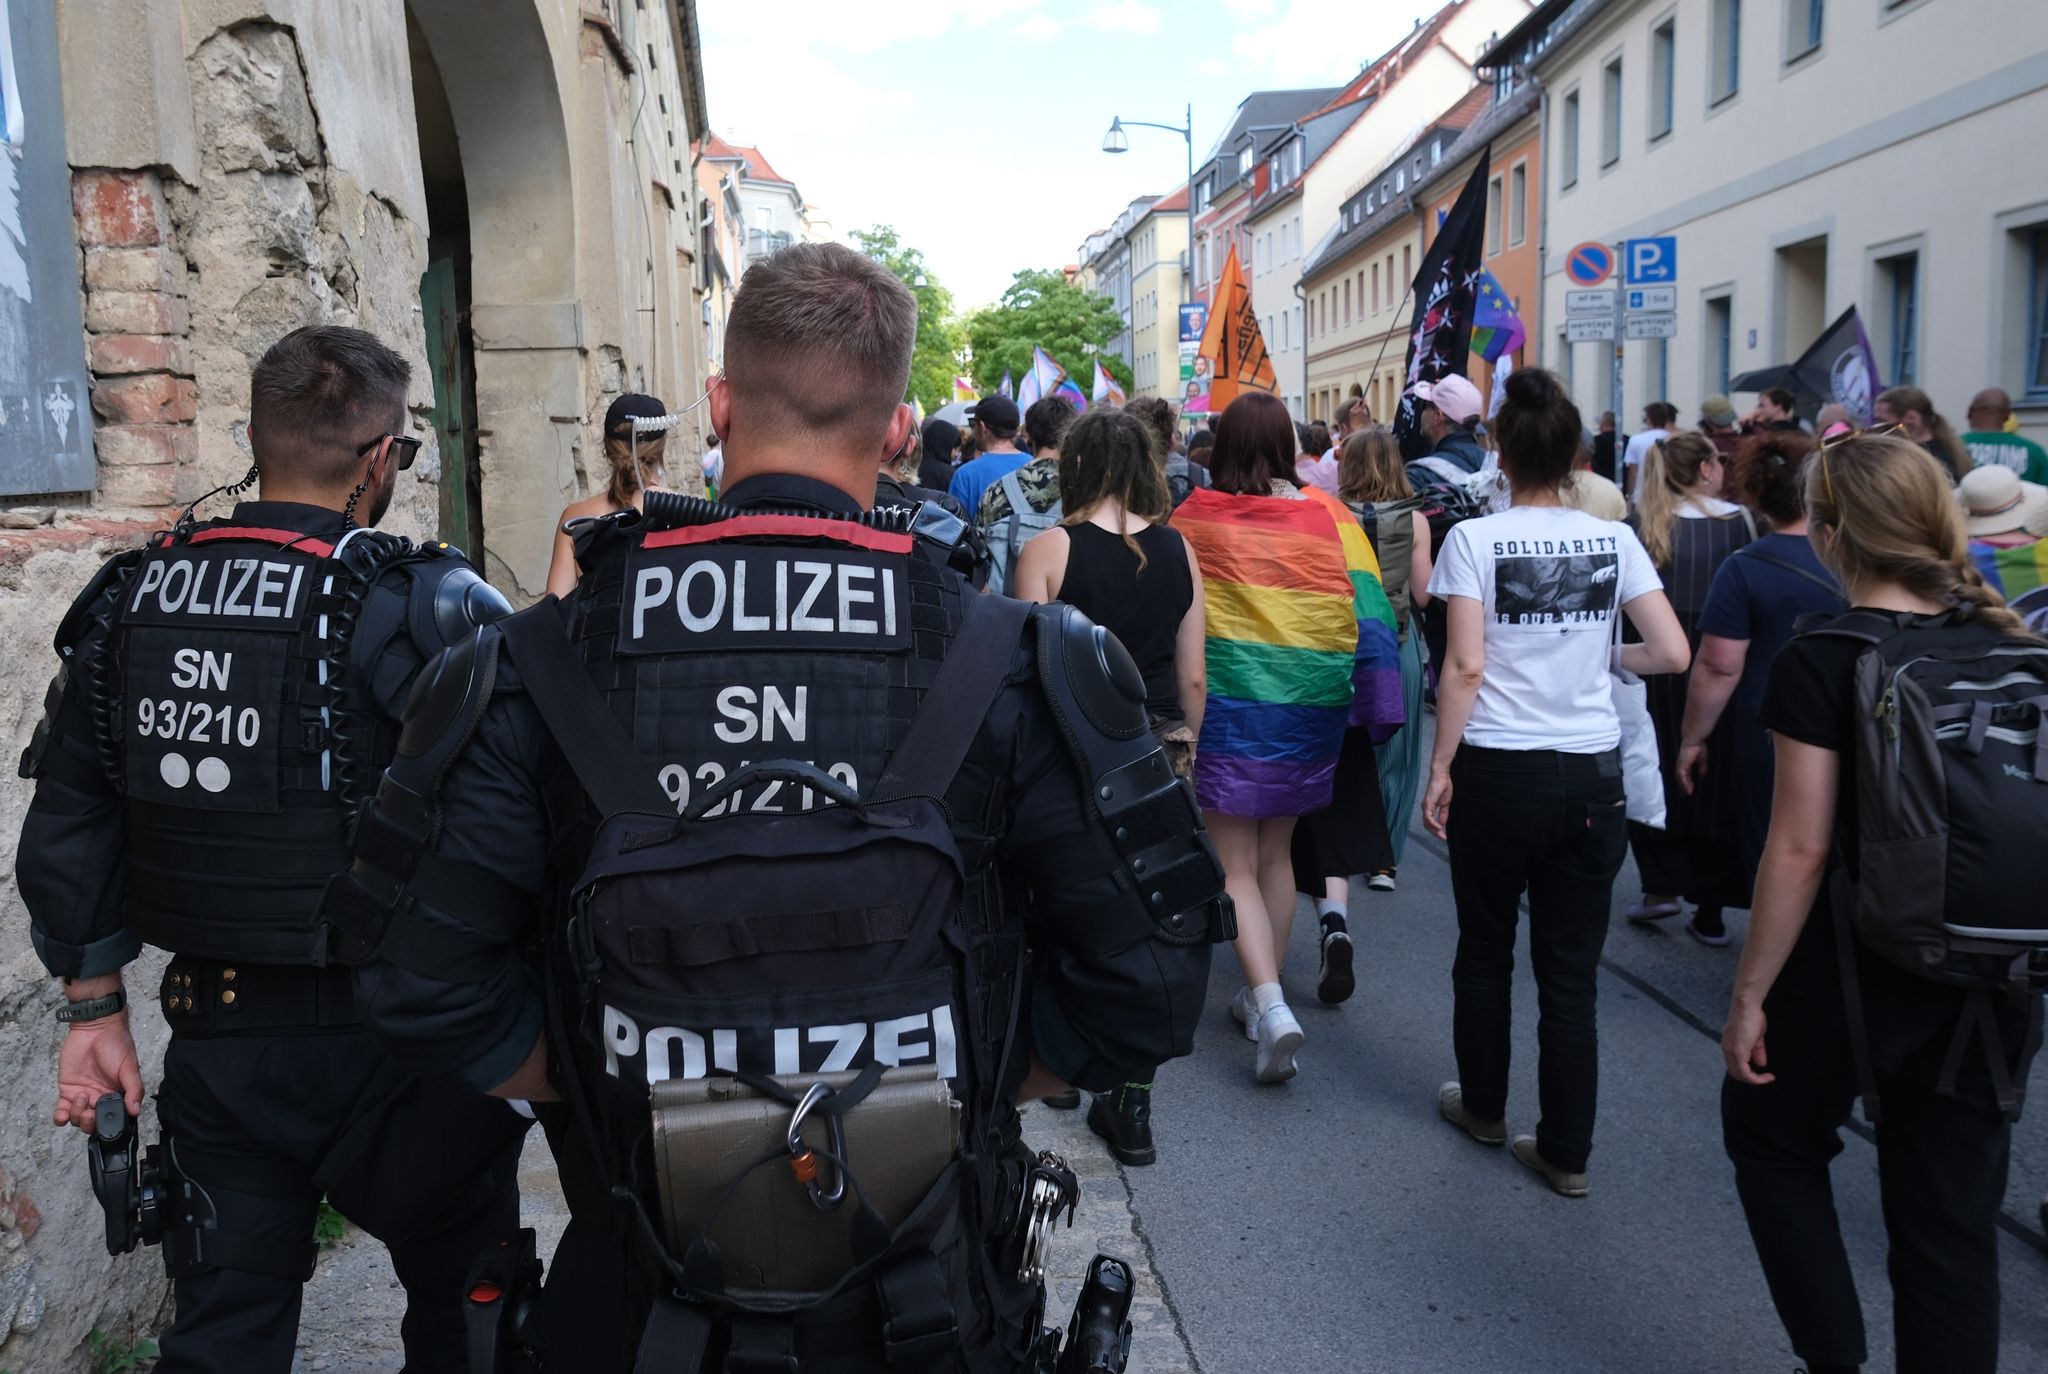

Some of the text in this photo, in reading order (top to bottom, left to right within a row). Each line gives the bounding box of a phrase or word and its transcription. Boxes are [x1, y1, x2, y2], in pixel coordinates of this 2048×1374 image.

[1493, 536, 1617, 556] SOLIDARITY
[131, 558, 305, 619] POLIZEI
[632, 559, 897, 640] POLIZEI
[1495, 608, 1614, 625] IS OUR WEAPO
[171, 648, 233, 692] SN
[137, 697, 261, 748] 93/210
[713, 685, 808, 744] SN
